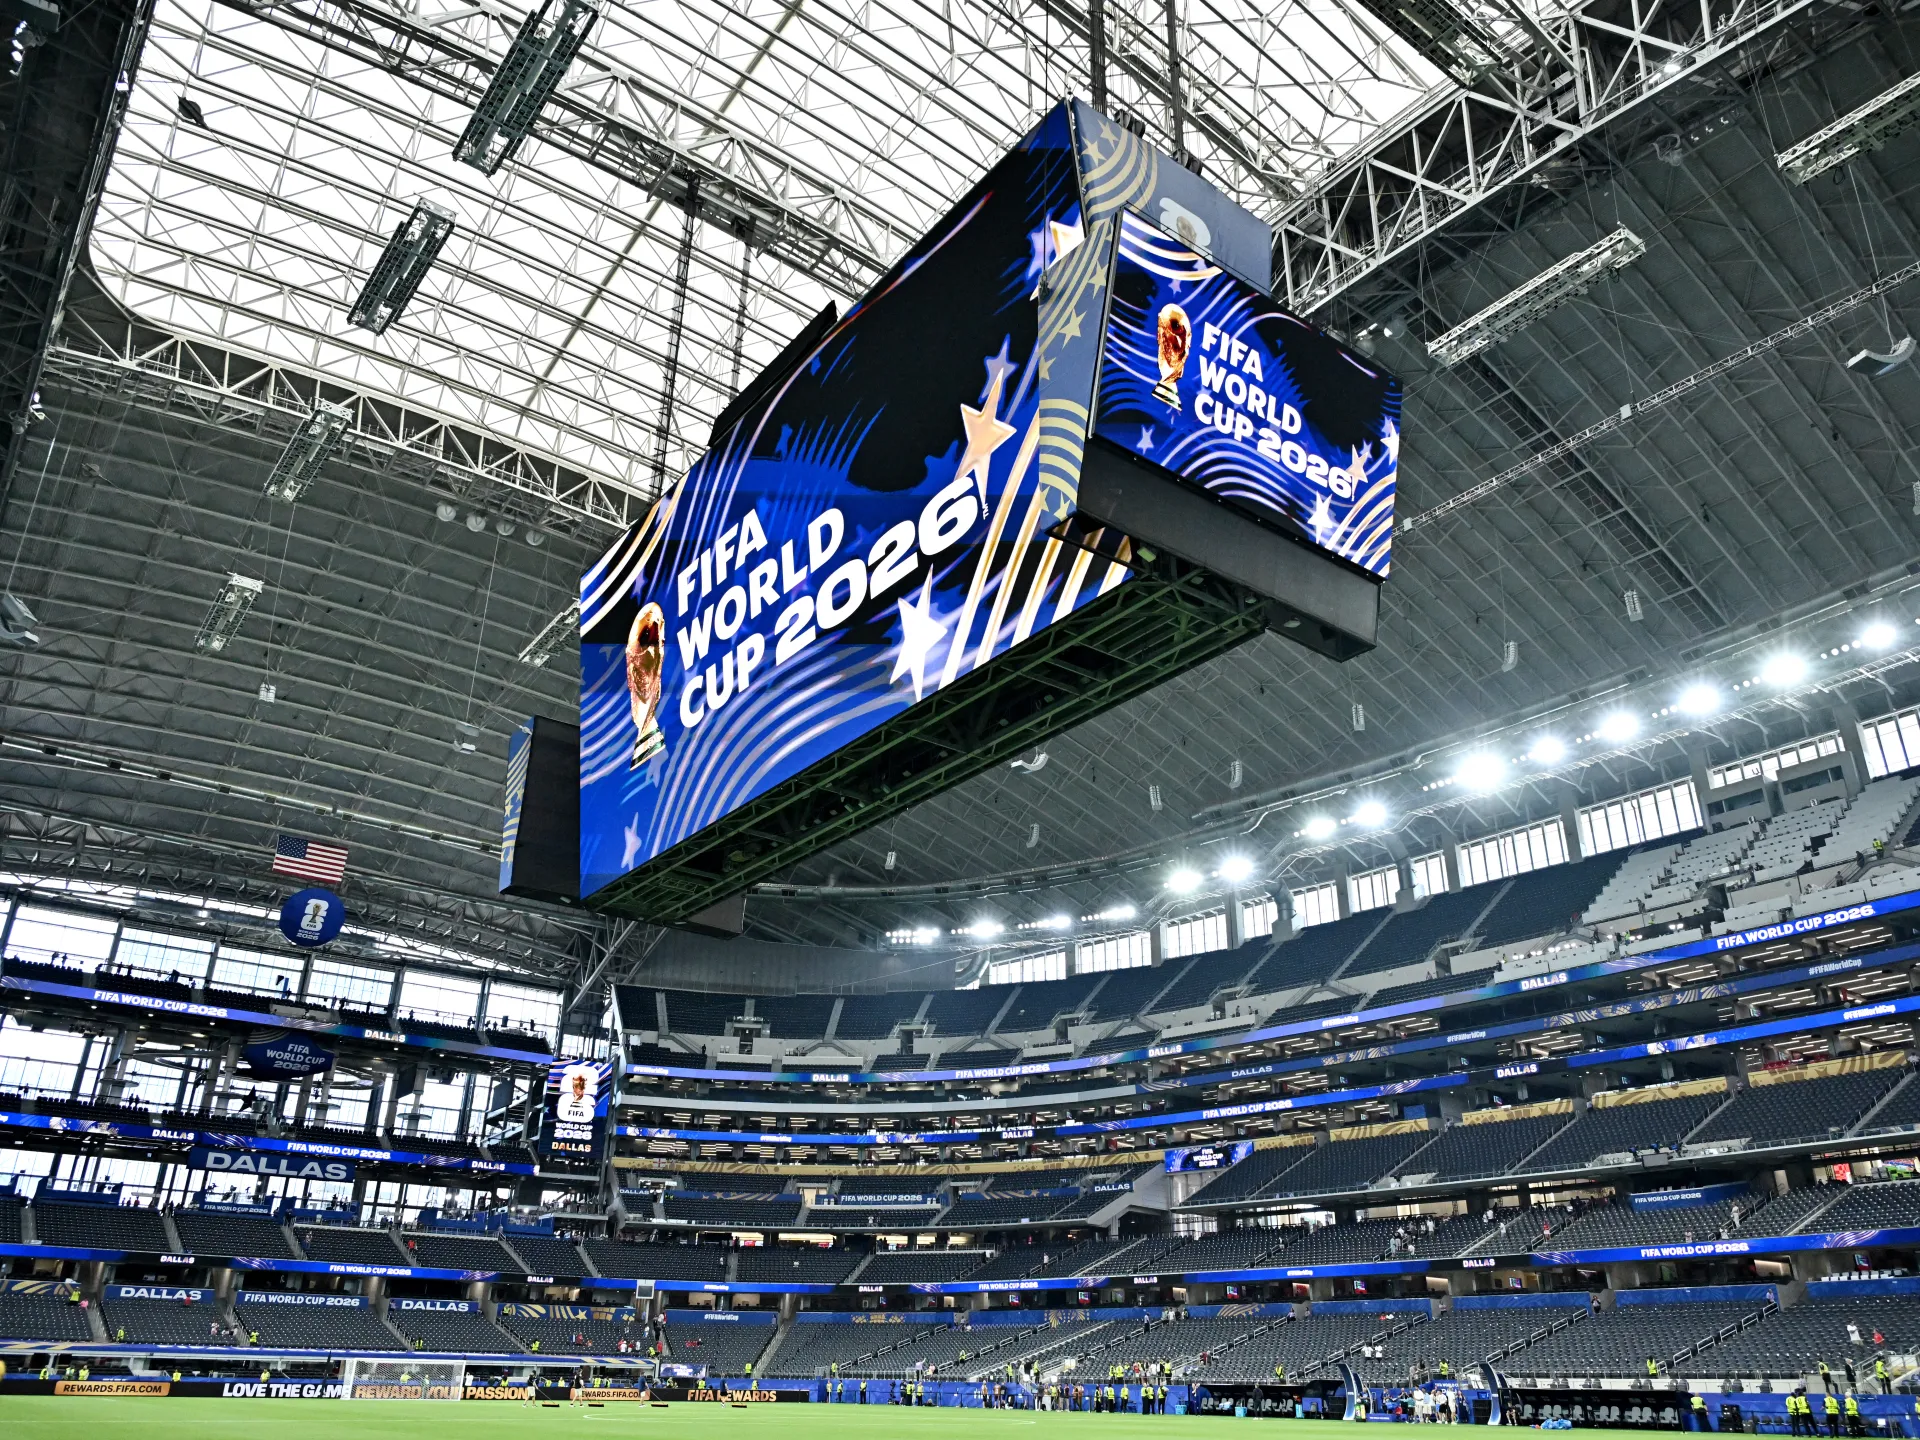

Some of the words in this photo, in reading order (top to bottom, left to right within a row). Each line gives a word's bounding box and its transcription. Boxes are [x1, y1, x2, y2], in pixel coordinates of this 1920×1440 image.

[1202, 321, 1264, 382] FIFA
[1199, 354, 1302, 435] WORLD
[1194, 396, 1255, 442] CUP
[1256, 428, 1352, 499] 2026
[677, 508, 768, 617] FIFA
[677, 508, 845, 671] WORLD
[678, 632, 766, 728] CUP
[774, 479, 979, 667] 2026
[1716, 935, 1744, 950] FIFA
[1745, 924, 1795, 943] WORLD
[1795, 917, 1822, 934] CUP
[1824, 905, 1875, 926] 2026
[296, 932, 319, 940] 2026
[1808, 958, 1862, 975] #FIFAWorldCup
[1521, 972, 1567, 990] DALLAS
[94, 990, 119, 1002] FIFA
[121, 994, 162, 1008] WORLD
[164, 1000, 187, 1012] CUP
[188, 1004, 227, 1016] 2026
[365, 1029, 406, 1043] DALLAS
[1447, 1031, 1486, 1042] #FIFAWorldCup
[287, 1044, 309, 1054] FIFA
[1148, 1045, 1182, 1057] DALLAS
[266, 1049, 303, 1061] WORLD
[305, 1056, 325, 1065] CUP
[273, 1061, 310, 1071] 2026
[974, 1068, 1004, 1077] WORLD
[1005, 1067, 1021, 1075] CUP
[1021, 1064, 1050, 1074] 2026
[1231, 1066, 1273, 1077] DALLAS
[1497, 1064, 1537, 1077] DALLAS
[812, 1074, 848, 1082] DALLAS
[1203, 1110, 1219, 1118] FIFA
[1219, 1106, 1247, 1117] WORLD
[1250, 1104, 1264, 1113] CUP
[1264, 1100, 1293, 1111] 2026
[555, 1122, 578, 1130] WORLD
[152, 1129, 195, 1140] DALLAS
[553, 1128, 592, 1140] 2026
[1002, 1130, 1033, 1139] DALLAS
[287, 1142, 307, 1151] FIFA
[308, 1144, 340, 1155] WORLD
[342, 1148, 359, 1157] CUP
[360, 1149, 391, 1160] 2026
[552, 1142, 591, 1152] DALLAS
[206, 1152, 347, 1180] DALLAS
[471, 1160, 505, 1171] DALLAS
[1094, 1183, 1130, 1192] DALLAS
[1640, 1249, 1660, 1257] FIFA
[1661, 1246, 1694, 1256] WORLD
[1695, 1245, 1714, 1254] CUP
[1715, 1242, 1749, 1253] 2026
[160, 1255, 195, 1263] DALLAS
[1462, 1258, 1495, 1268] DALLAS
[346, 1265, 371, 1273] WORLD
[120, 1287, 202, 1300] DALLAS
[244, 1293, 266, 1302] FIFA
[269, 1294, 304, 1304] WORLD
[305, 1296, 325, 1305] CUP
[326, 1297, 360, 1306] 2026
[401, 1300, 469, 1311] DALLAS
[63, 1384, 162, 1393] REWARDS.FIFA.COM
[222, 1383, 268, 1397] LOVE
[268, 1384, 302, 1397] THE
[355, 1386, 422, 1399] REWARD
[467, 1387, 528, 1400] PASSION
[688, 1390, 714, 1401] FIFA
